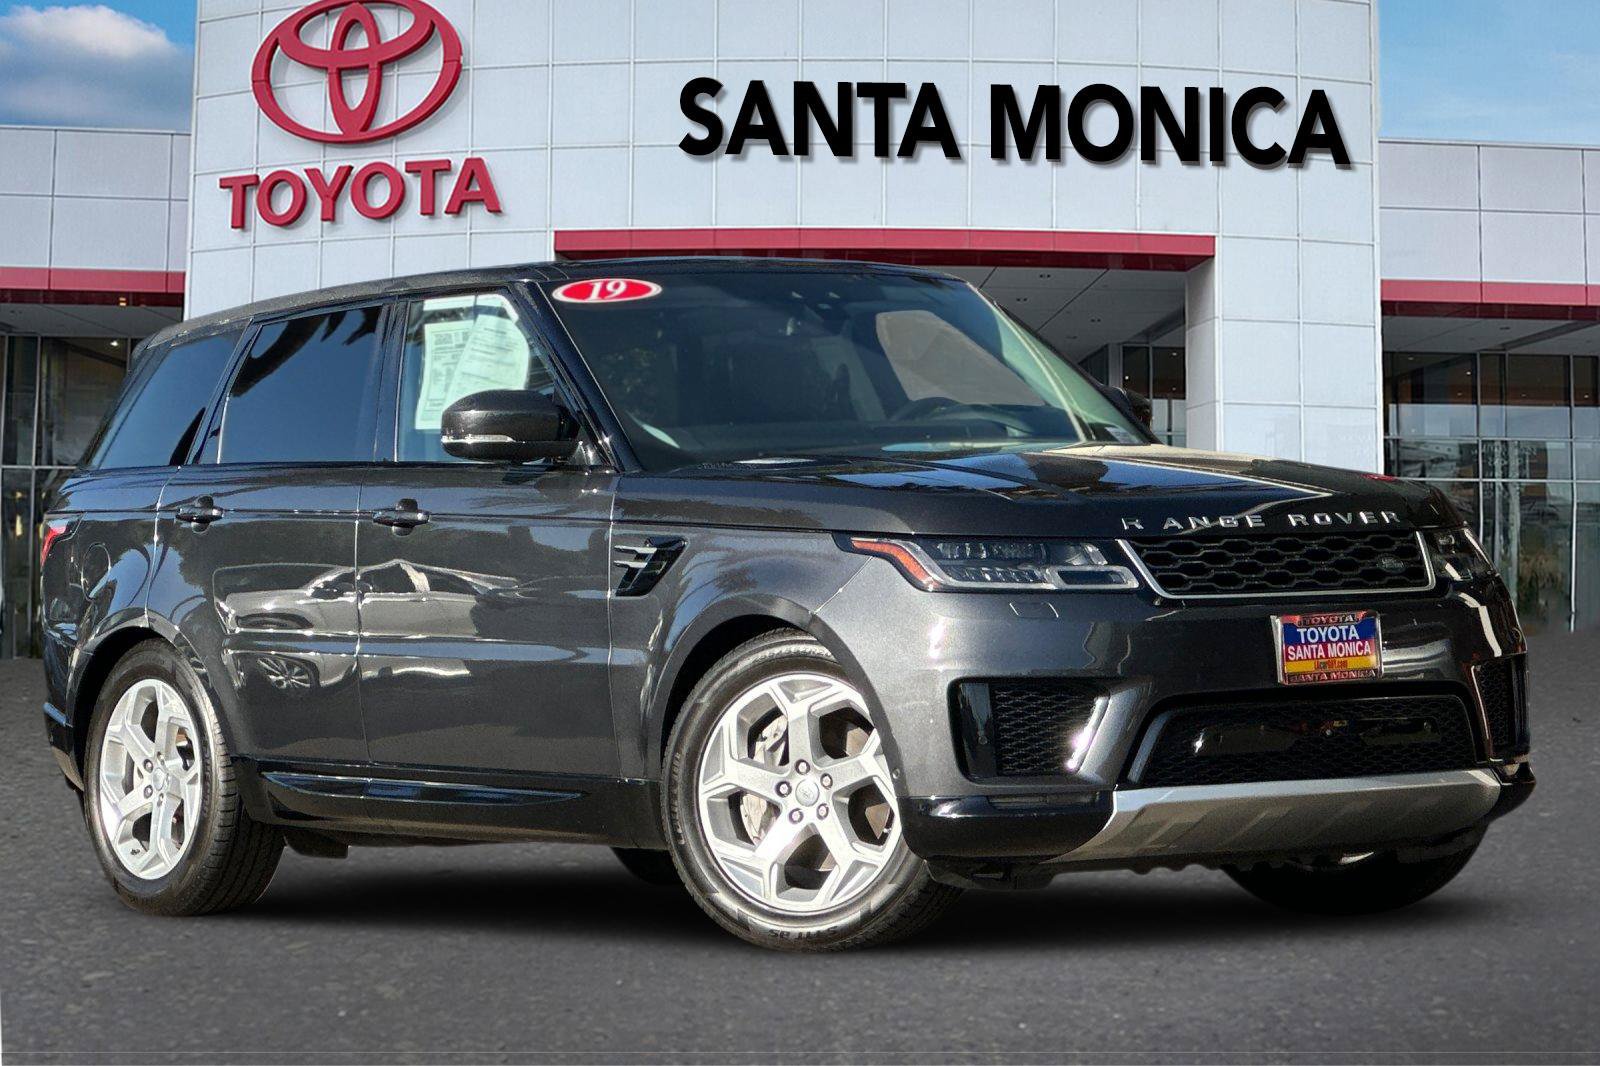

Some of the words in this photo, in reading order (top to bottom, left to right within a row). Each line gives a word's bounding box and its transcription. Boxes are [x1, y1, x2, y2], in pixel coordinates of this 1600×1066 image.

[678, 77, 961, 160] SANTA
[989, 82, 1352, 169] MONICA
[219, 157, 502, 230] TOYOTA
[586, 280, 627, 301] 19
[1121, 514, 1266, 531] RANGE
[1287, 509, 1401, 527] ROVER
[1305, 614, 1354, 625] TOYOTA
[1297, 625, 1360, 644] TOYOTA
[1288, 643, 1326, 660] SANTA
[1327, 641, 1371, 658] MONICA
[1291, 671, 1328, 682] SANTA
[1330, 669, 1376, 681] MONICA
